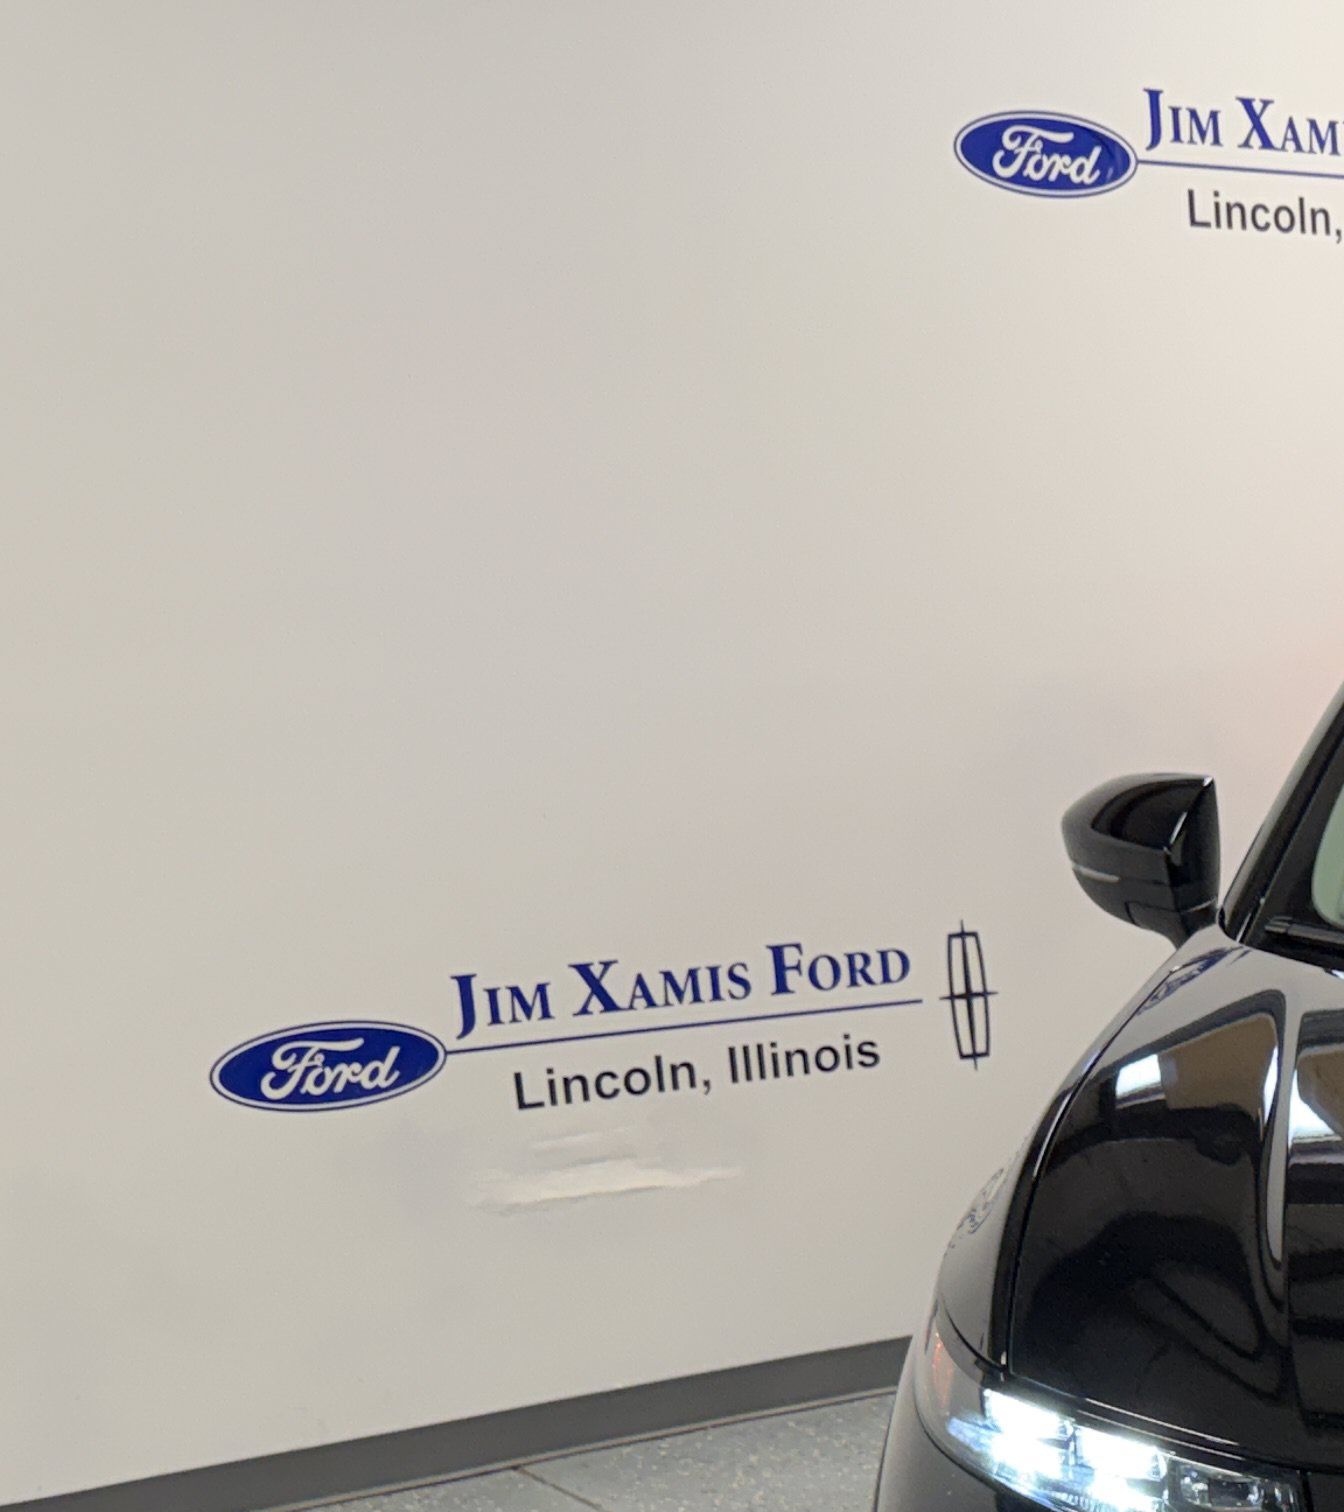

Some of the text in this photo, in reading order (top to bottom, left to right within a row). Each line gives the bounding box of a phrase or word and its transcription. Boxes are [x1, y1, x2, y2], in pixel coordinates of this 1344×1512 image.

[991, 124, 1102, 185] Ford
[1187, 189, 1344, 244] Lincoln,
[259, 1038, 400, 1100] Ford
[512, 1032, 881, 1110] Lincoln, Illinois
